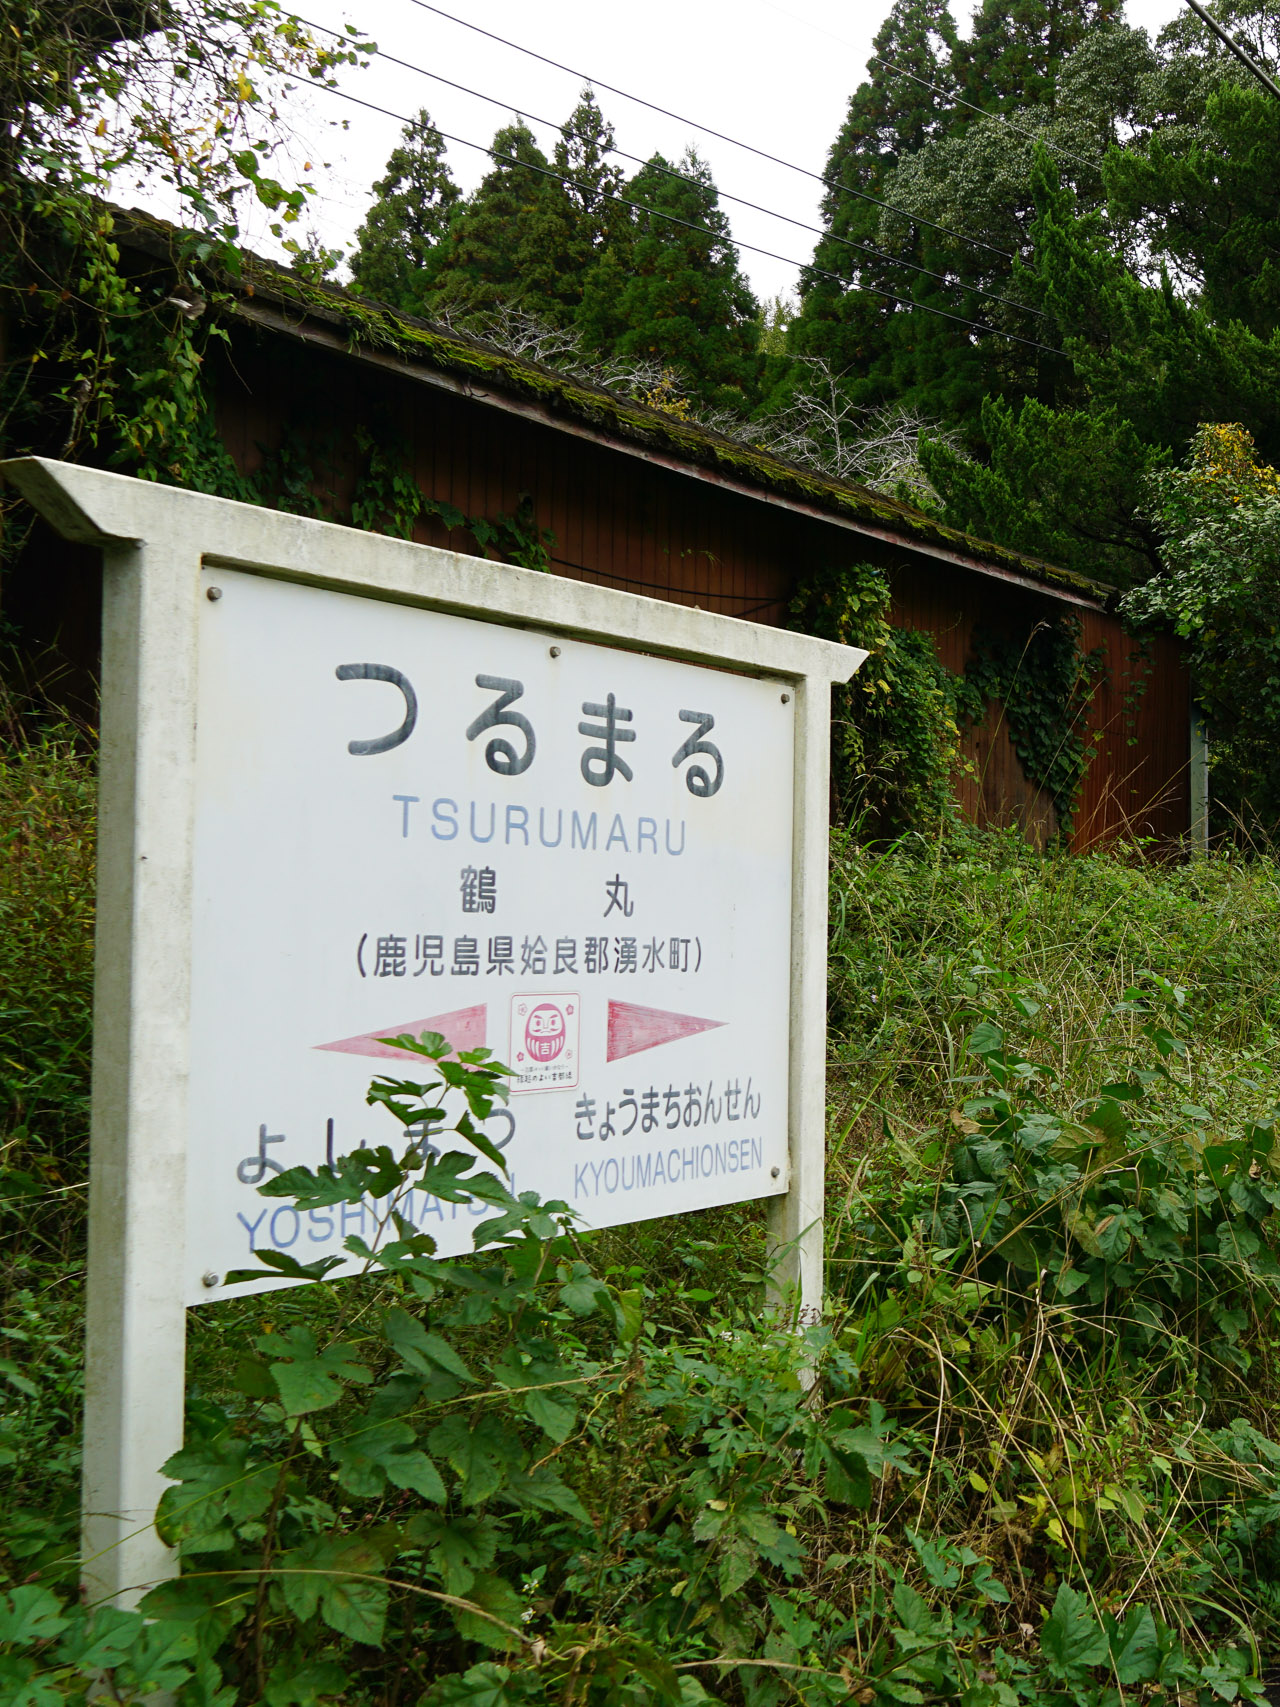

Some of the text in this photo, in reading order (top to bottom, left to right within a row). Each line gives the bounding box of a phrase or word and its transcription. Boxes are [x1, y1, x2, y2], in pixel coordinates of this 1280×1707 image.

[335, 662, 725, 799] つるまる
[392, 794, 686, 857] TSURUMARU
[460, 865, 634, 918] 鶴丸
[356, 933, 702, 977] (鹿児島県姶良郡湧水町)
[539, 1042, 551, 1055] 吉
[574, 1077, 762, 1141] きょうまちおんせん
[574, 1136, 763, 1199] KYOUMACHIONSEN
